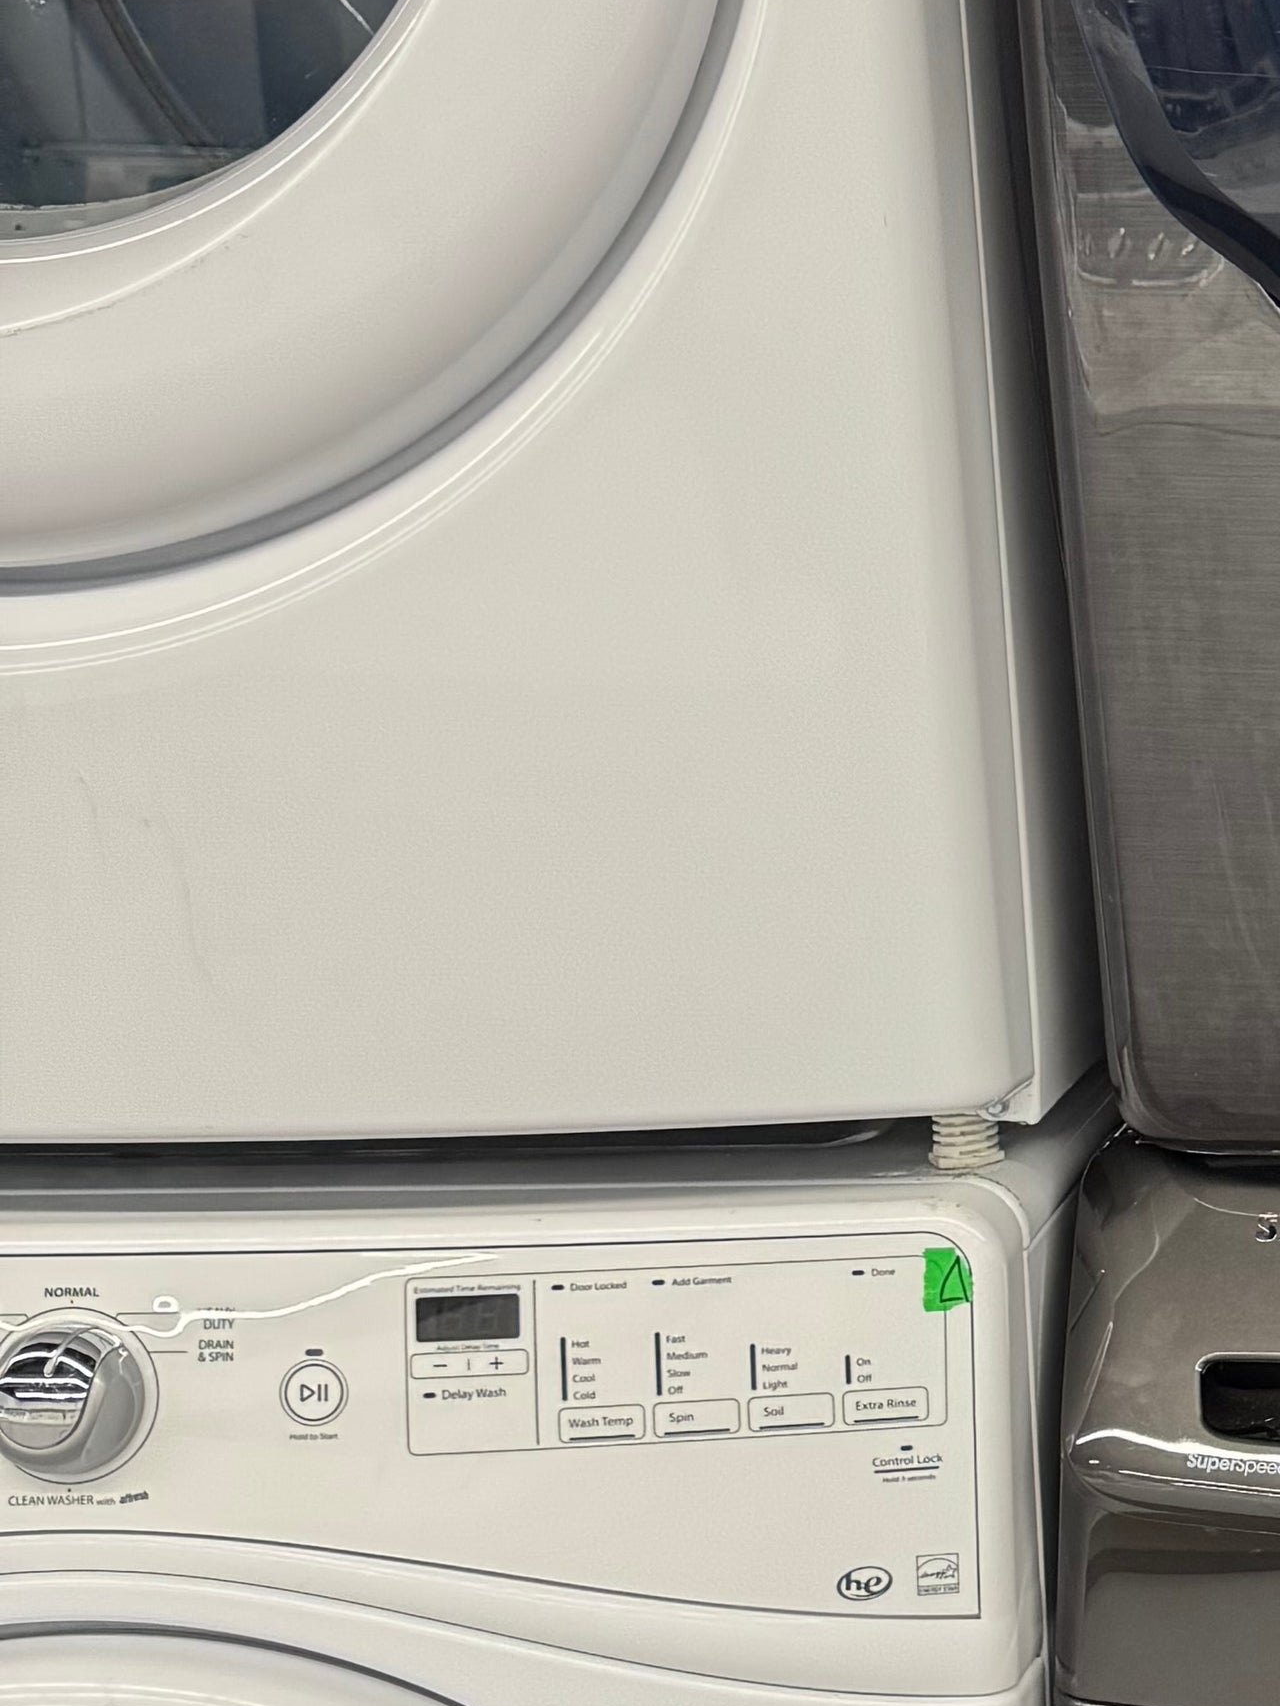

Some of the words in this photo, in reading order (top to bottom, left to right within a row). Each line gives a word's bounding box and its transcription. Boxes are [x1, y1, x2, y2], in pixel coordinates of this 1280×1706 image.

[871, 1268, 895, 1276] Done
[44, 1288, 98, 1297] NORMAL
[204, 1319, 234, 1330] DUTY
[199, 1339, 234, 1350] DRAIN
[198, 1352, 206, 1362] &
[209, 1352, 234, 1361] SPIN
[442, 1390, 473, 1401] Delay
[476, 1389, 506, 1398] Wash
[764, 1407, 784, 1416] Soil
[569, 1419, 599, 1427] Wash
[602, 1417, 634, 1427] Temp
[670, 1413, 694, 1423] Spin
[873, 1457, 914, 1467] Control
[917, 1454, 942, 1464] Lock
[8, 1494, 44, 1506] CLEAN
[48, 1494, 94, 1505] WASHER
